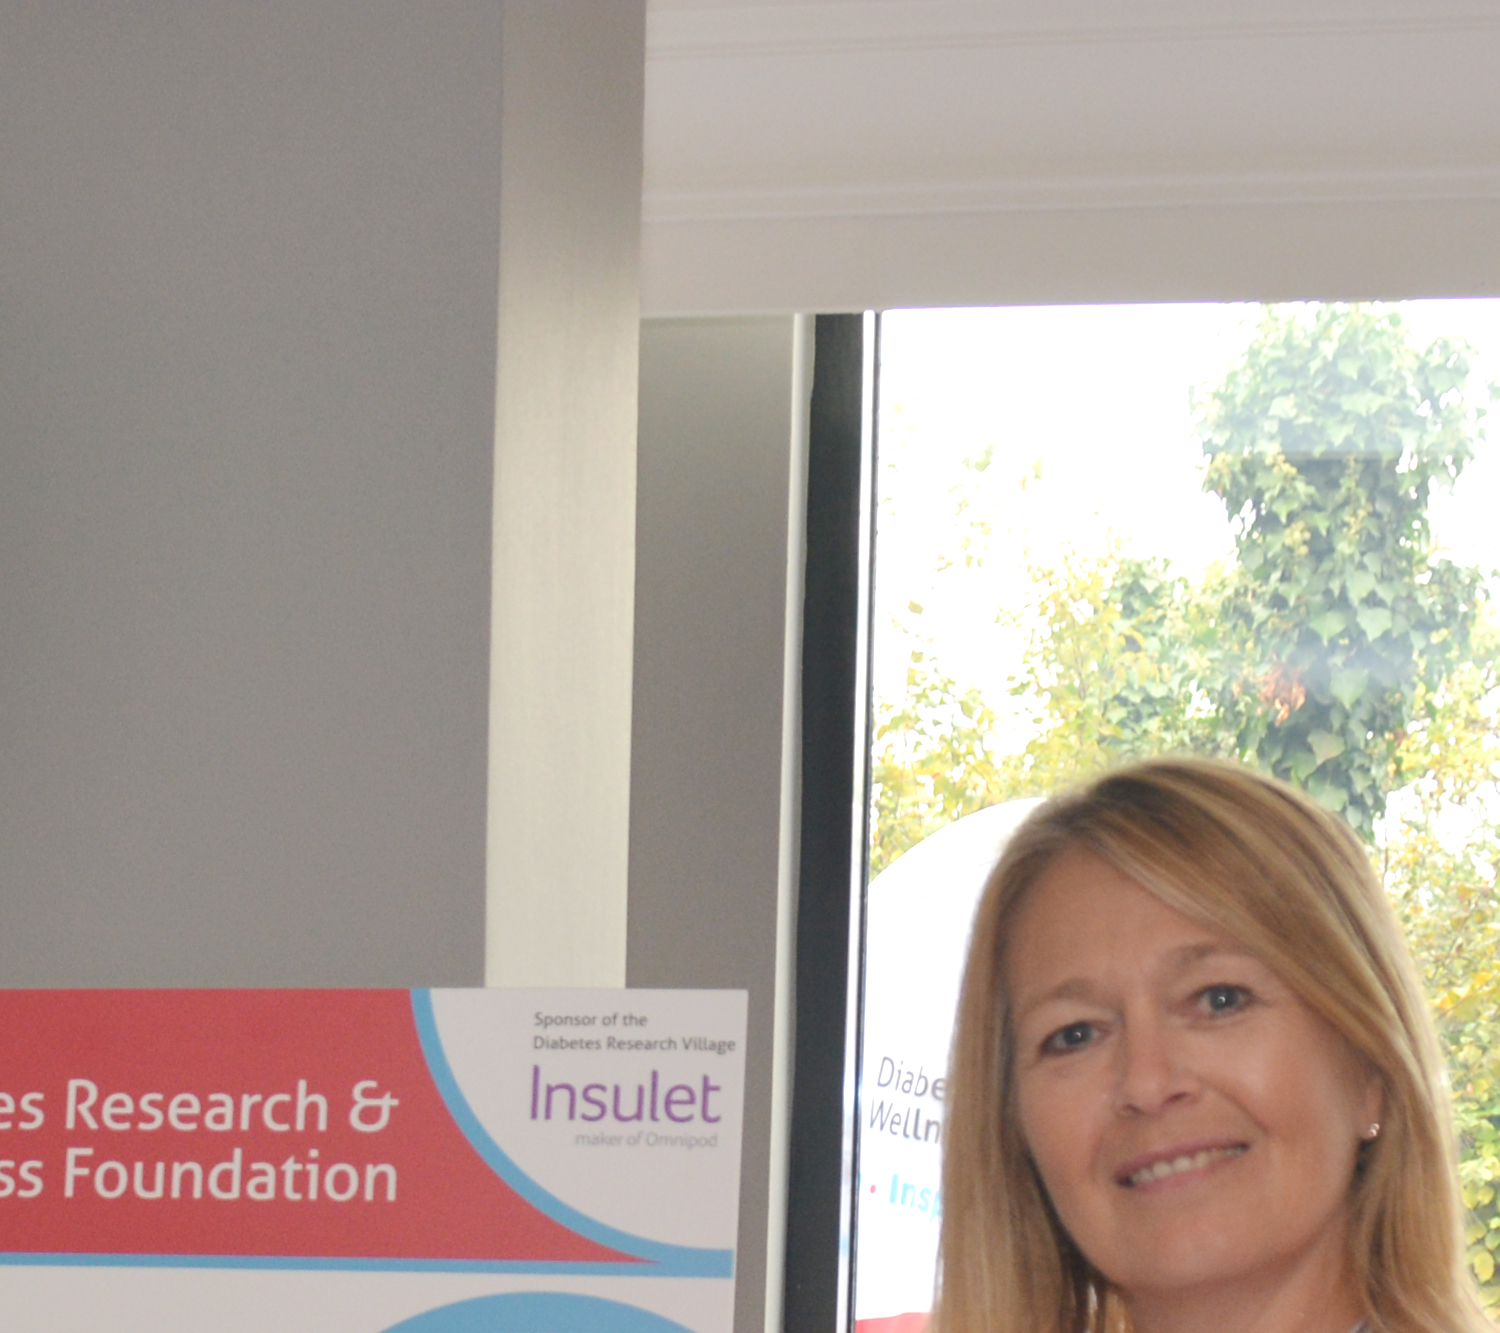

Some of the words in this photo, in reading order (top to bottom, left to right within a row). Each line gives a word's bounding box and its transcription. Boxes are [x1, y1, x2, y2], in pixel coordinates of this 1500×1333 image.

[533, 1035, 602, 1050] Diabetes
[606, 1035, 677, 1051] Research
[681, 1036, 736, 1055] Village
[534, 1011, 597, 1029] Sponsor
[601, 1012, 618, 1026] of
[622, 1012, 648, 1027] the
[65, 1078, 328, 1132] Research
[348, 1079, 399, 1133] &
[530, 1064, 721, 1123] Insulet
[64, 1147, 397, 1202] Foundation
